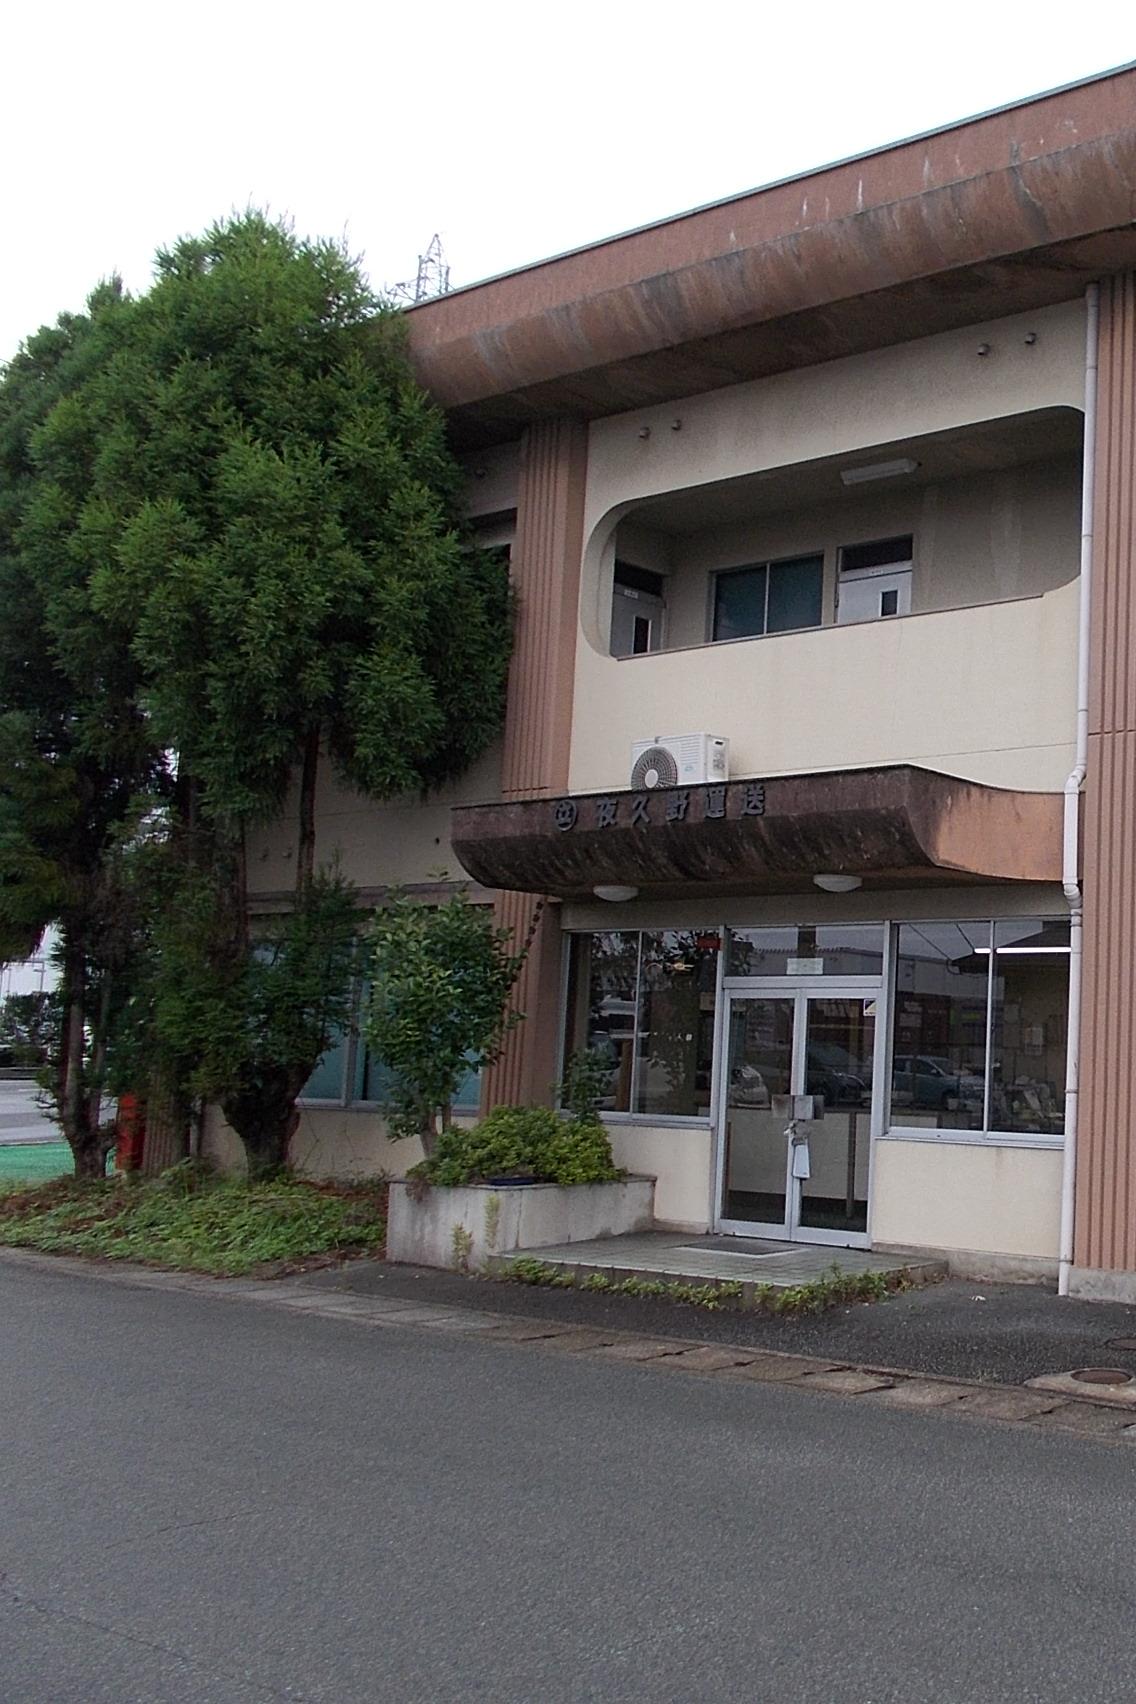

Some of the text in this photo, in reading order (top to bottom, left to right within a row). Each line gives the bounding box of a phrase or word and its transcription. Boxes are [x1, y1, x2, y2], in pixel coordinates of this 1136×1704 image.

[597, 784, 765, 828] 夜久野運送
